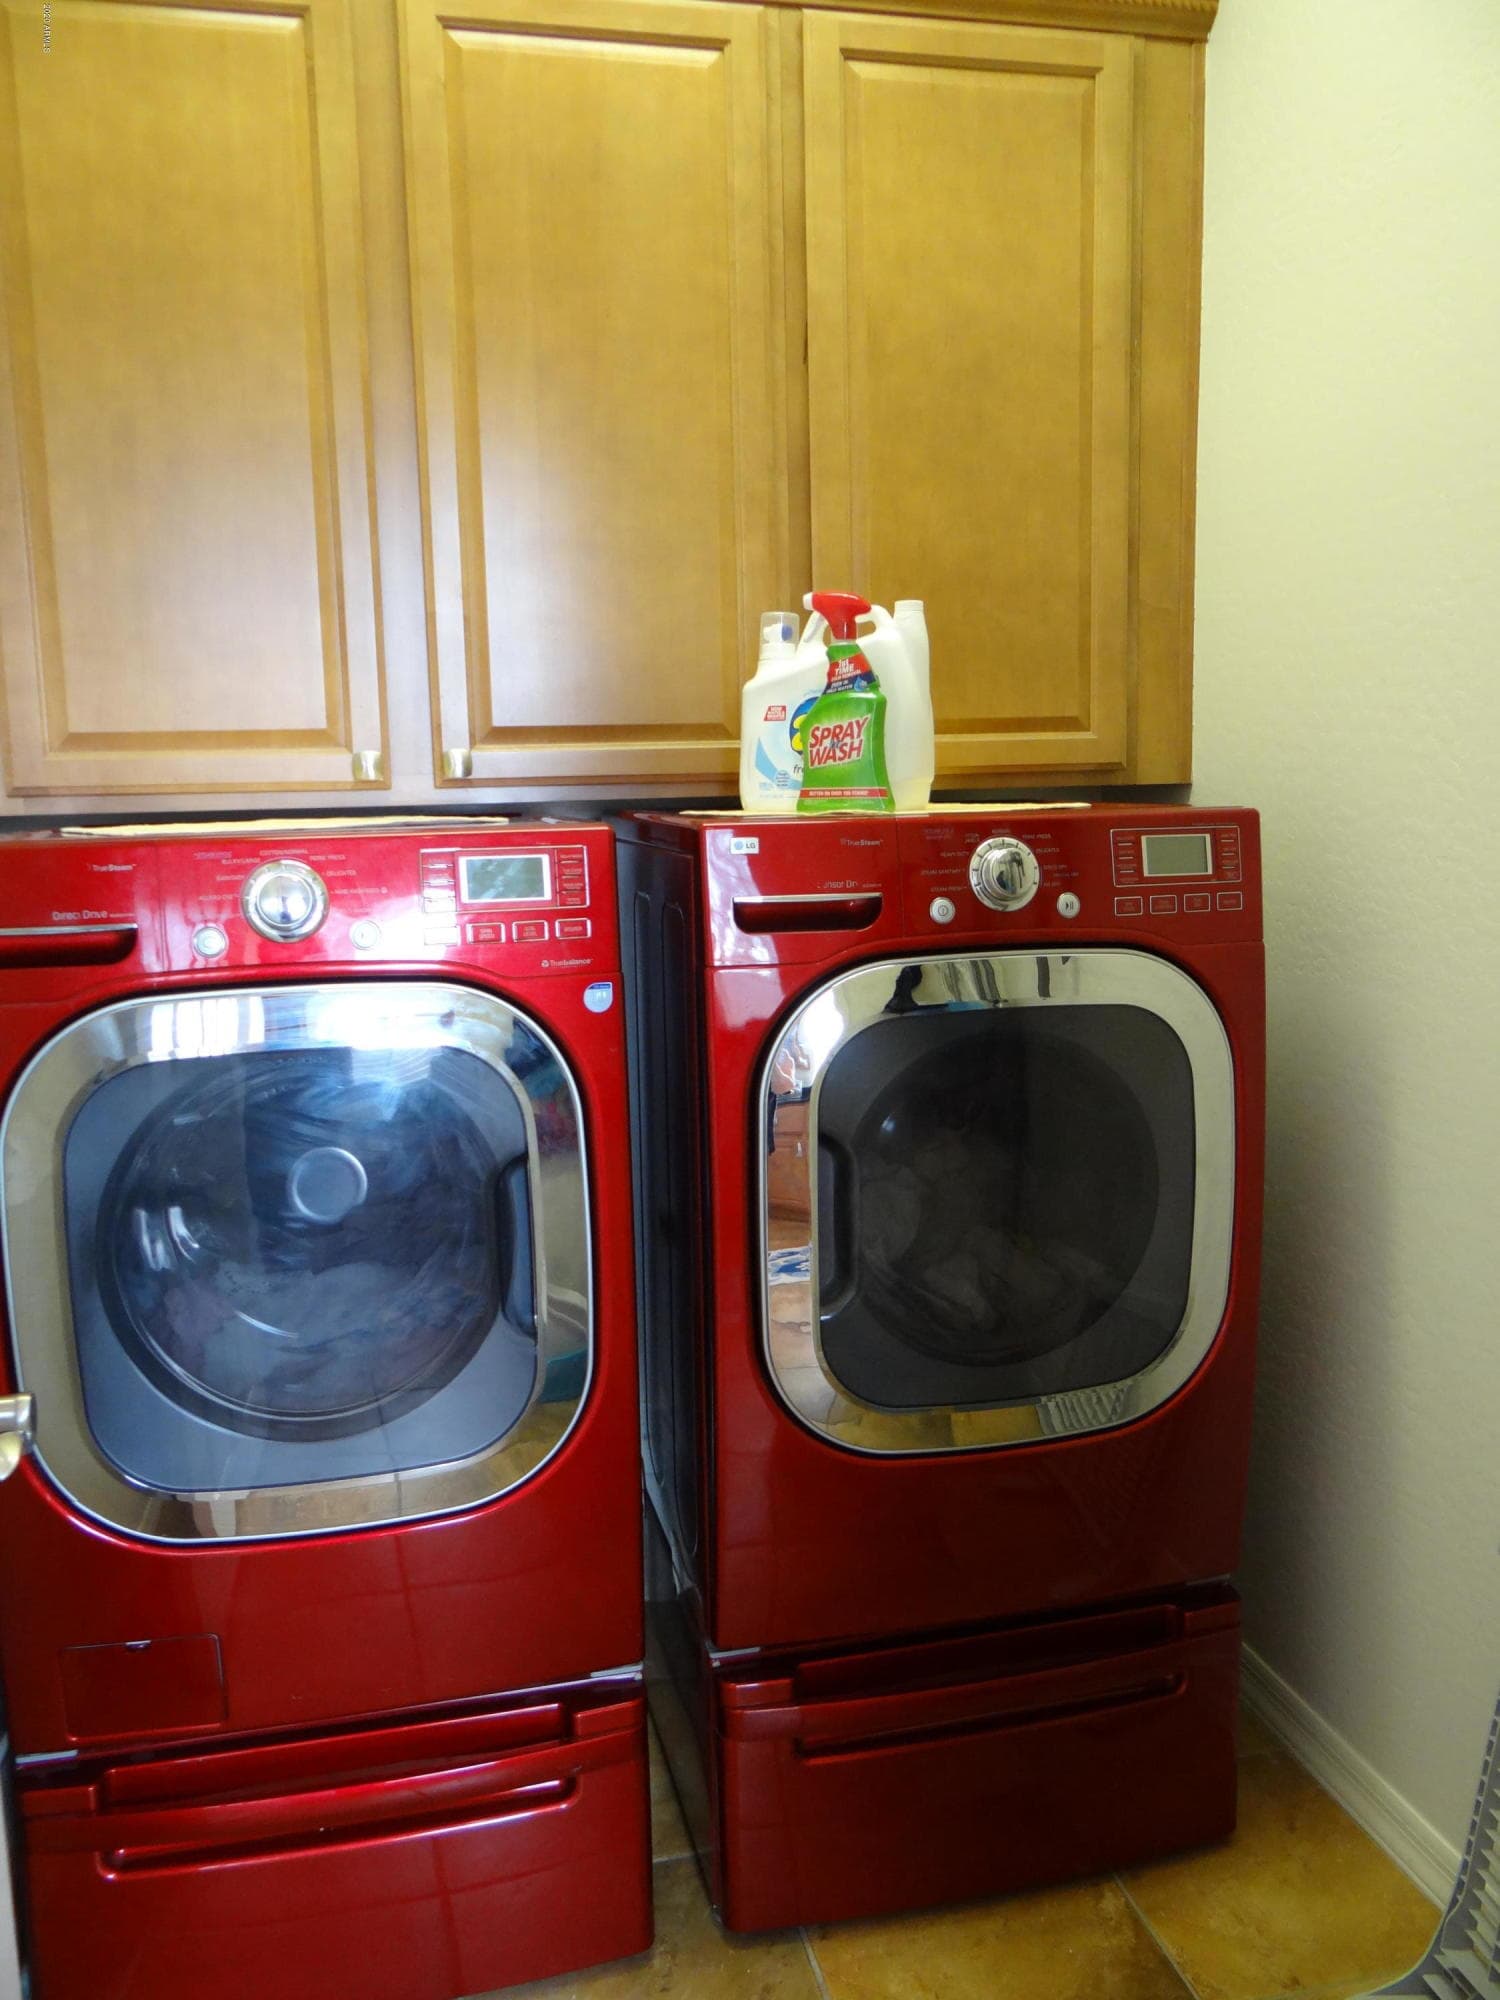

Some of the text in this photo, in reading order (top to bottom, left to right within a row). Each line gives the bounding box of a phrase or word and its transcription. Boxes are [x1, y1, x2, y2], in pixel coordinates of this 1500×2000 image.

[809, 716, 869, 749] SPRAY
[809, 739, 863, 767] WASH
[82, 909, 108, 919] Drive
